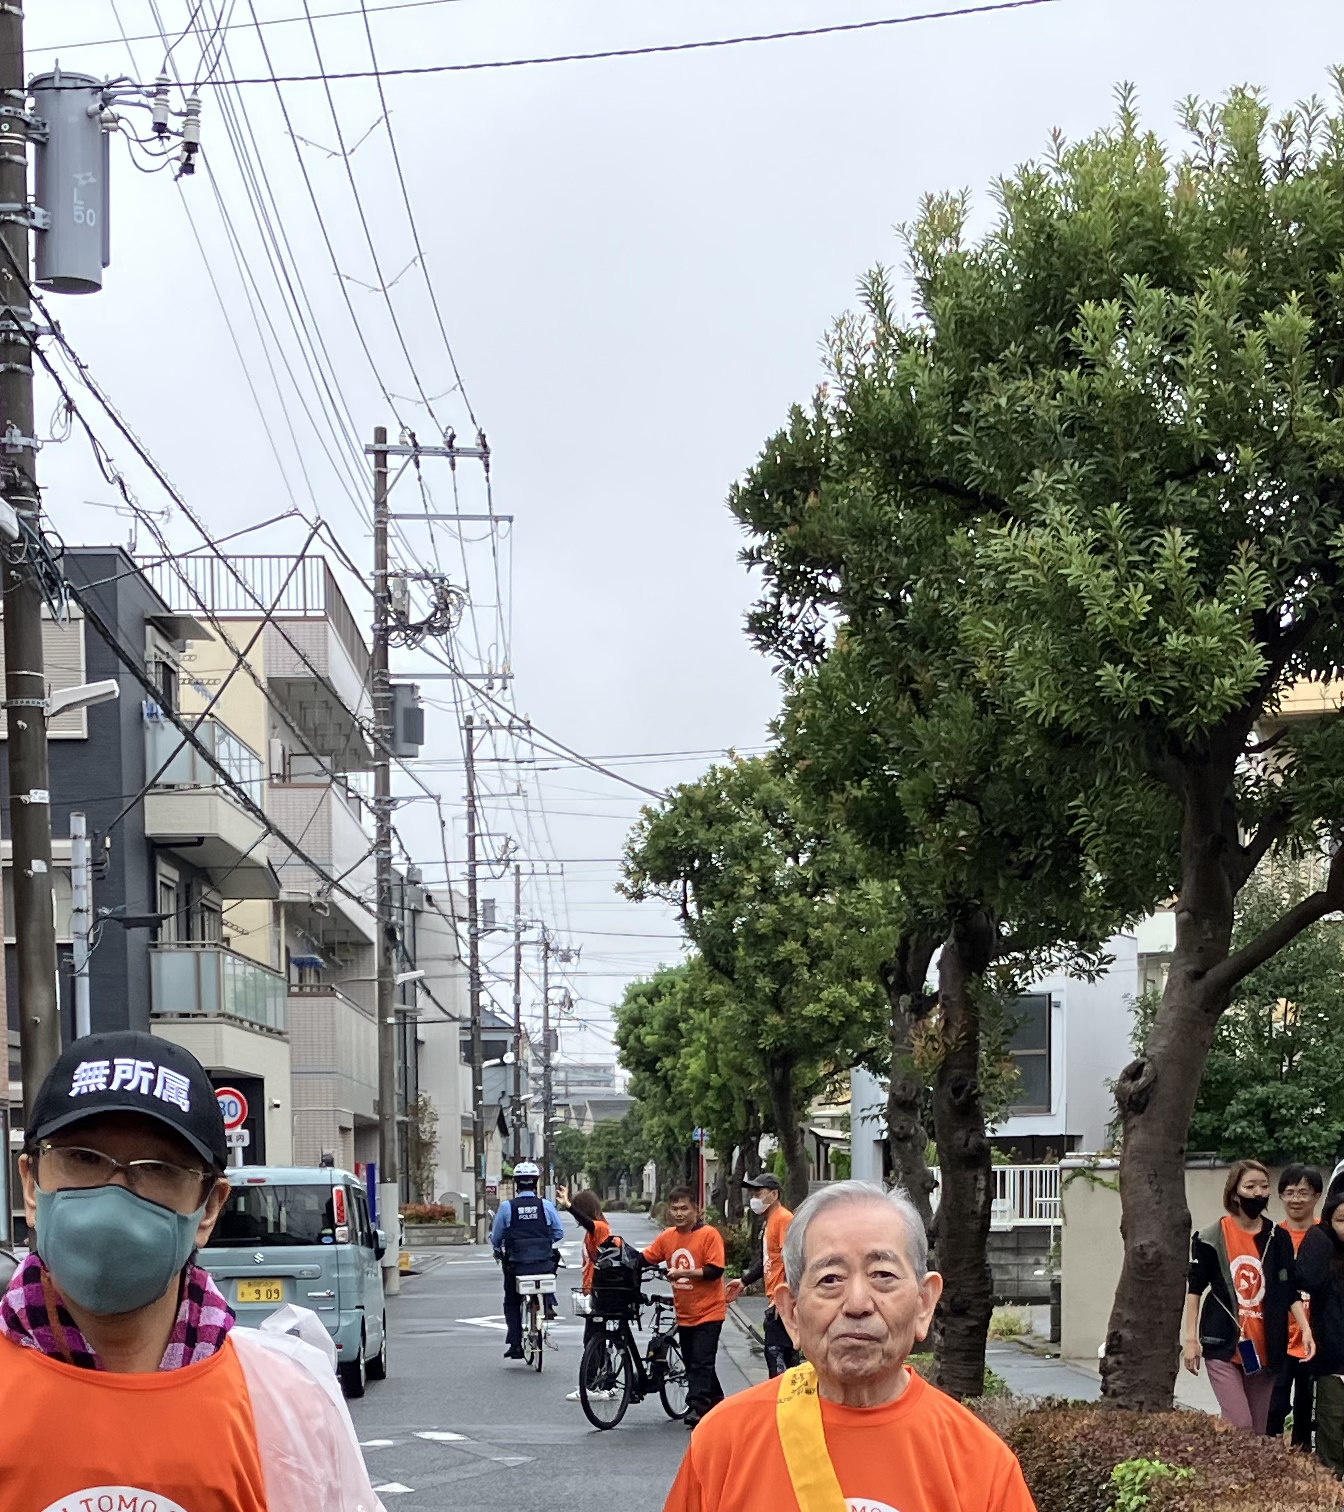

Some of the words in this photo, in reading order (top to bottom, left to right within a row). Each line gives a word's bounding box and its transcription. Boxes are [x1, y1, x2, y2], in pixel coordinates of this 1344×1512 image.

[73, 205, 96, 227] 50
[68, 1058, 191, 1113] 無所属
